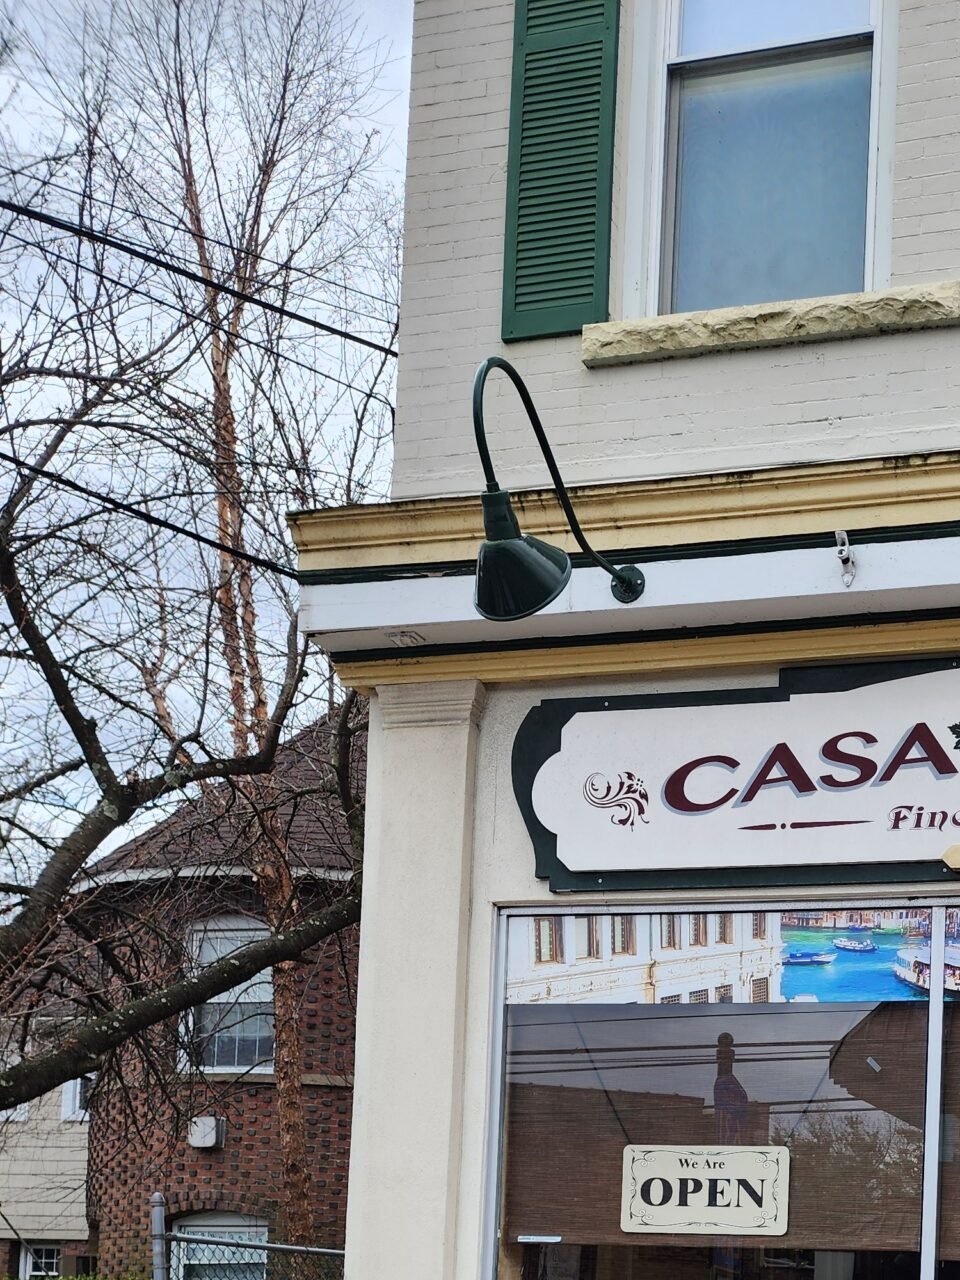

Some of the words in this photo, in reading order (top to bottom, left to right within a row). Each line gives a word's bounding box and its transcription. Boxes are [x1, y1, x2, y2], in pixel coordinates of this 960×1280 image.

[662, 722, 958, 815] CASA
[679, 1158, 699, 1169] We
[702, 1158, 725, 1169] Are
[640, 1177, 767, 1208] OPEN
